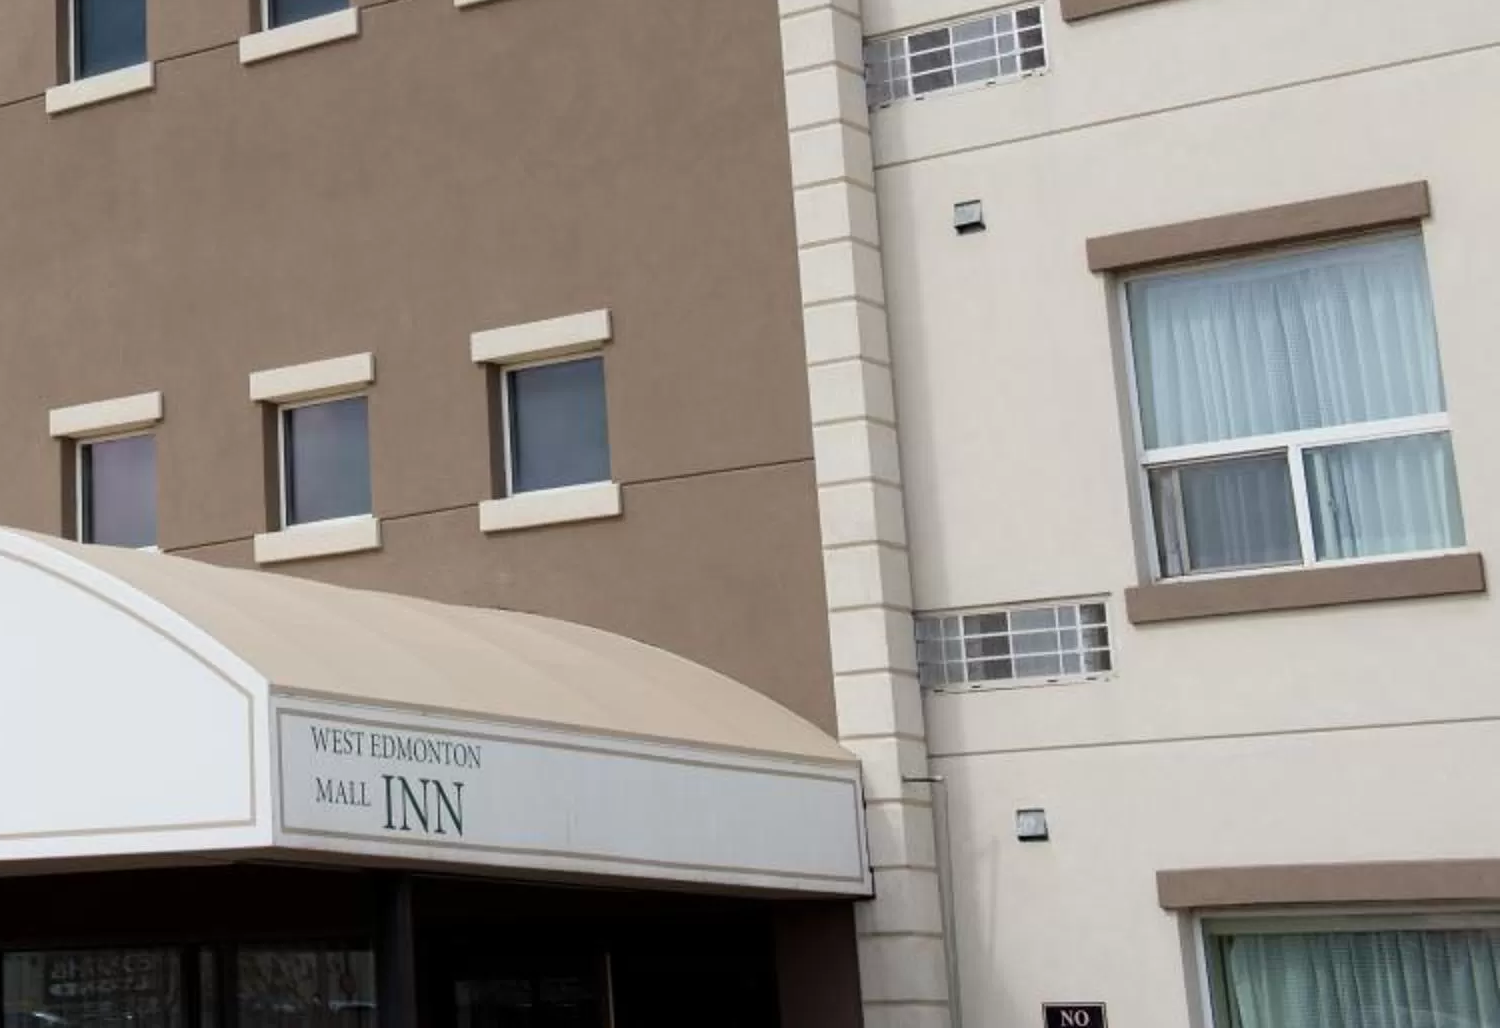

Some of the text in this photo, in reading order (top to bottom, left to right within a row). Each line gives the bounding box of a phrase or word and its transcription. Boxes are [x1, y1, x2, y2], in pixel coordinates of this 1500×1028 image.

[311, 726, 480, 768] WEST EDMONTON
[316, 774, 464, 836] MALL INN
[1060, 1009, 1090, 1027] NO
